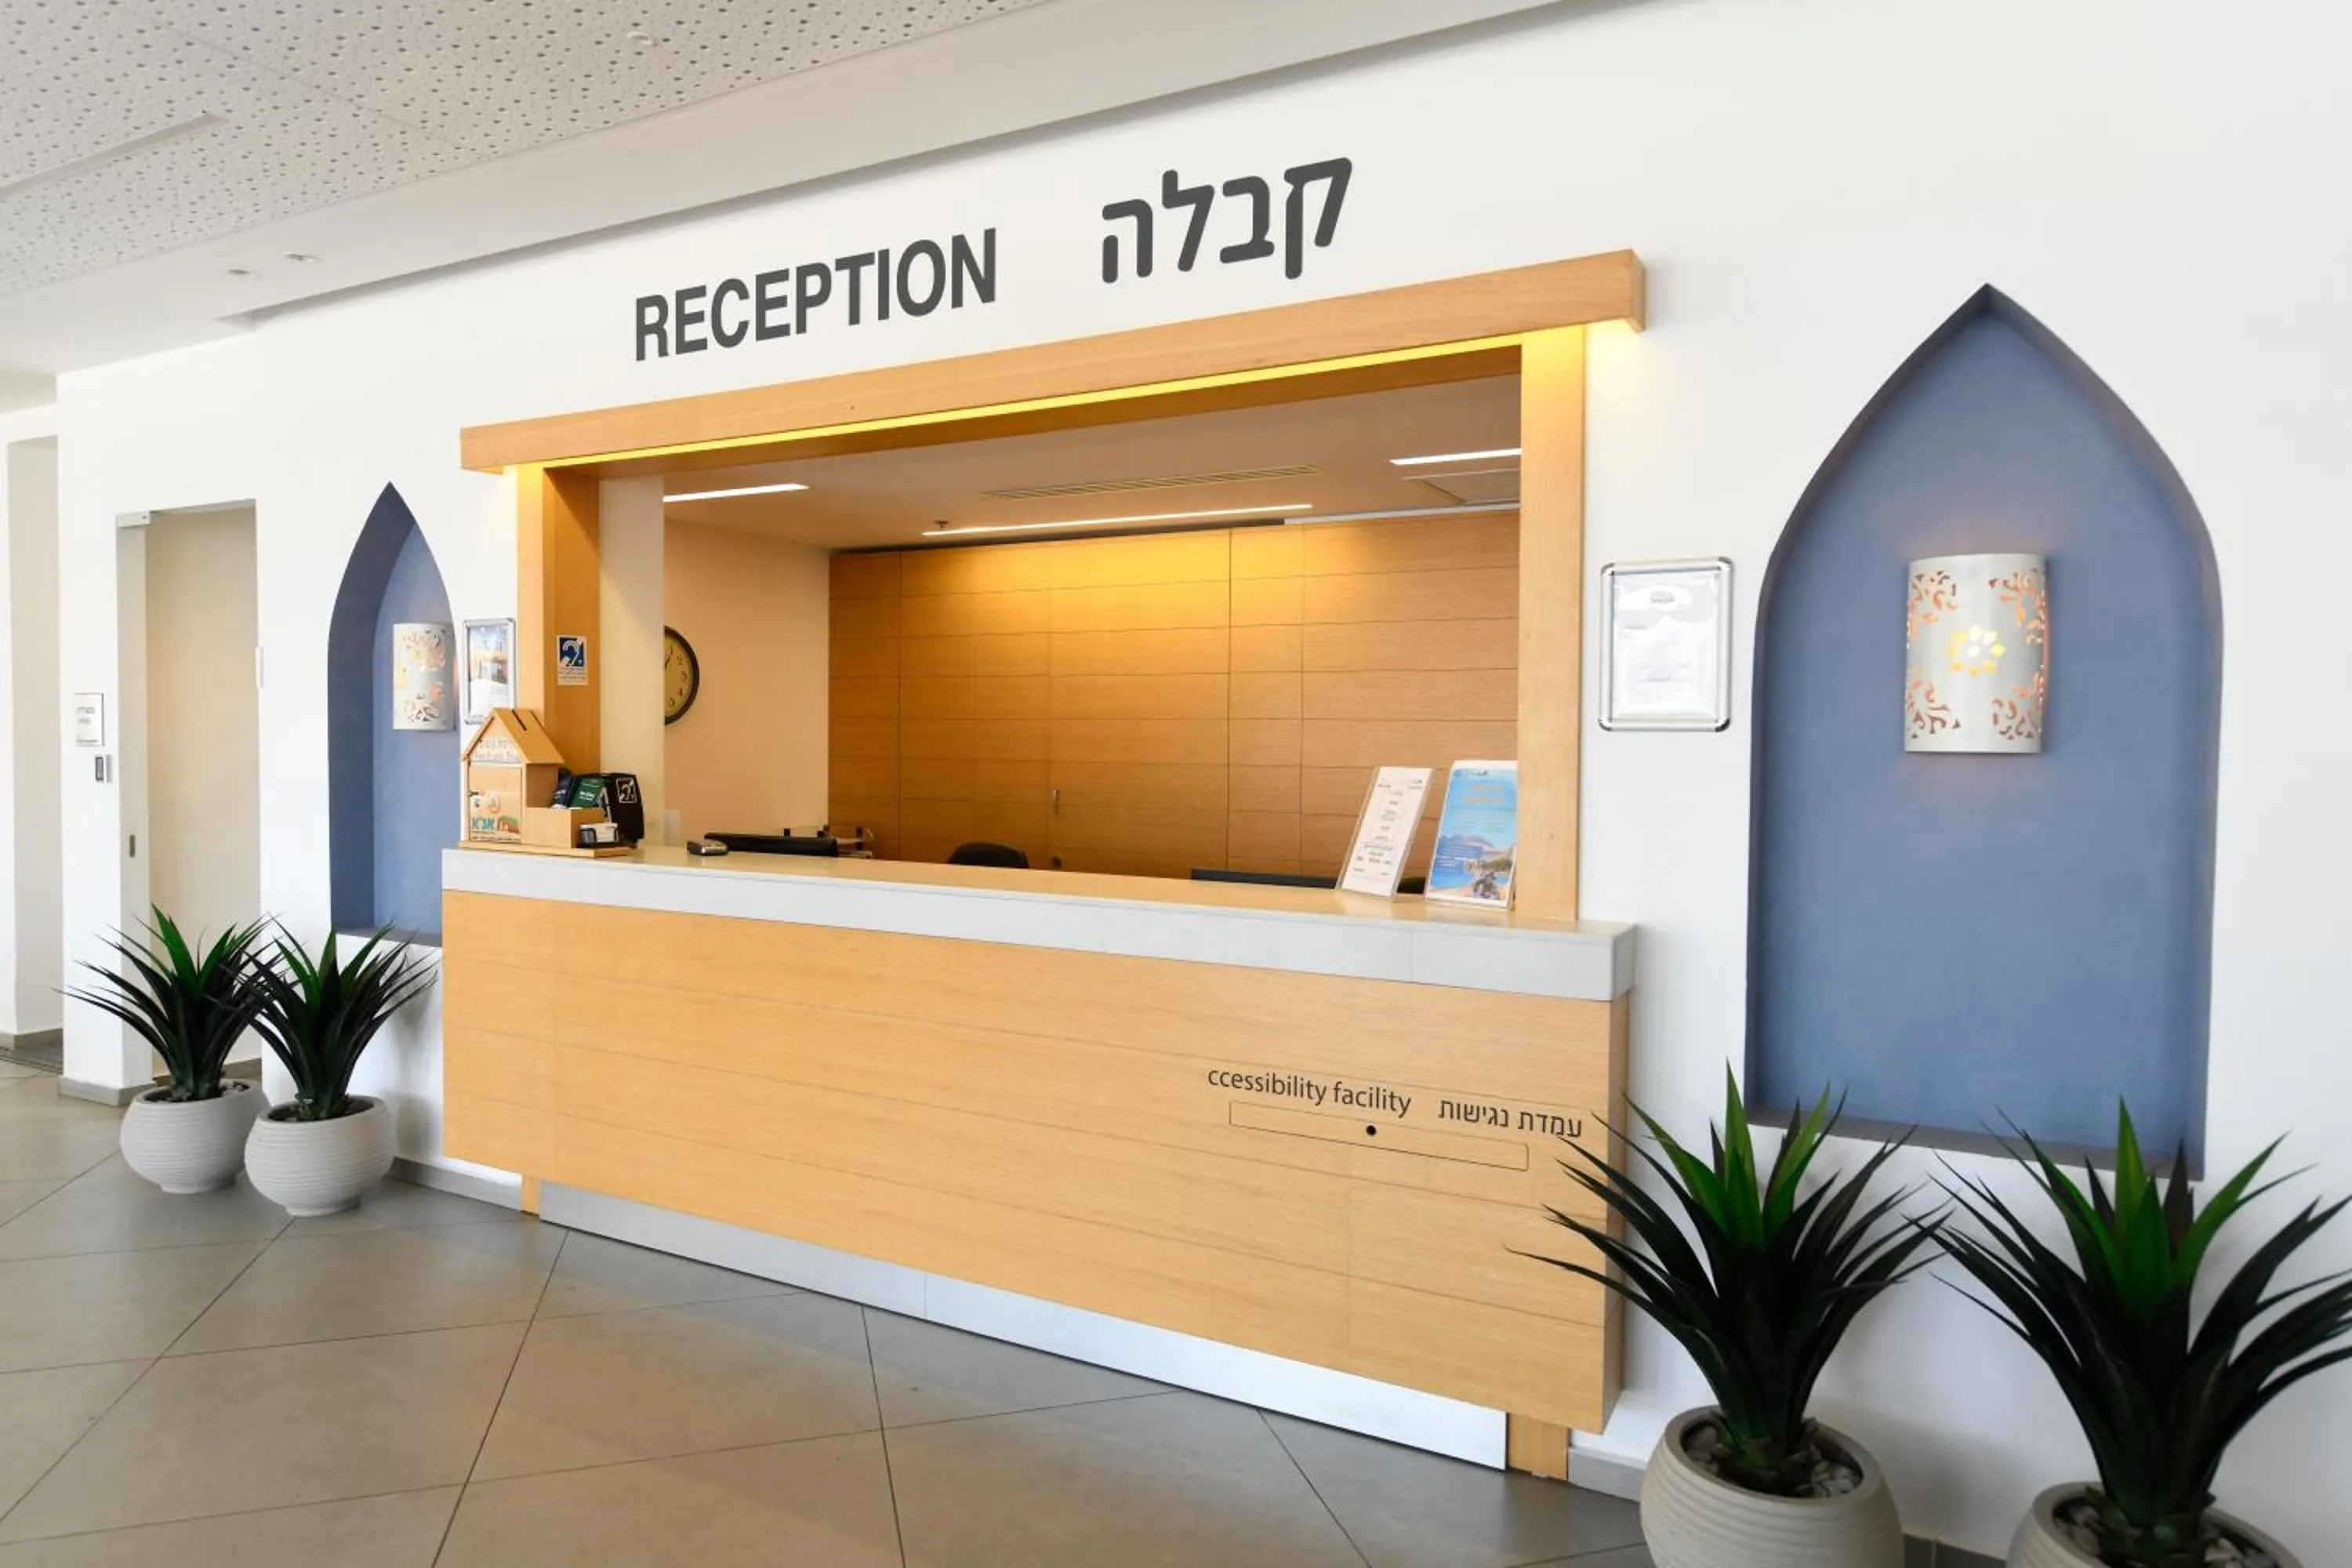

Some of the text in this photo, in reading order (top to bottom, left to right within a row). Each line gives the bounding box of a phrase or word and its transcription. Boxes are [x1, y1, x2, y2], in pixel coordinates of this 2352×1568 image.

[1102, 157, 1352, 284] קבלה
[636, 228, 996, 361] RECEPTION
[1208, 1070, 1411, 1119] ccessibility facility
[1439, 1100, 1581, 1138] עמדת נגישות
